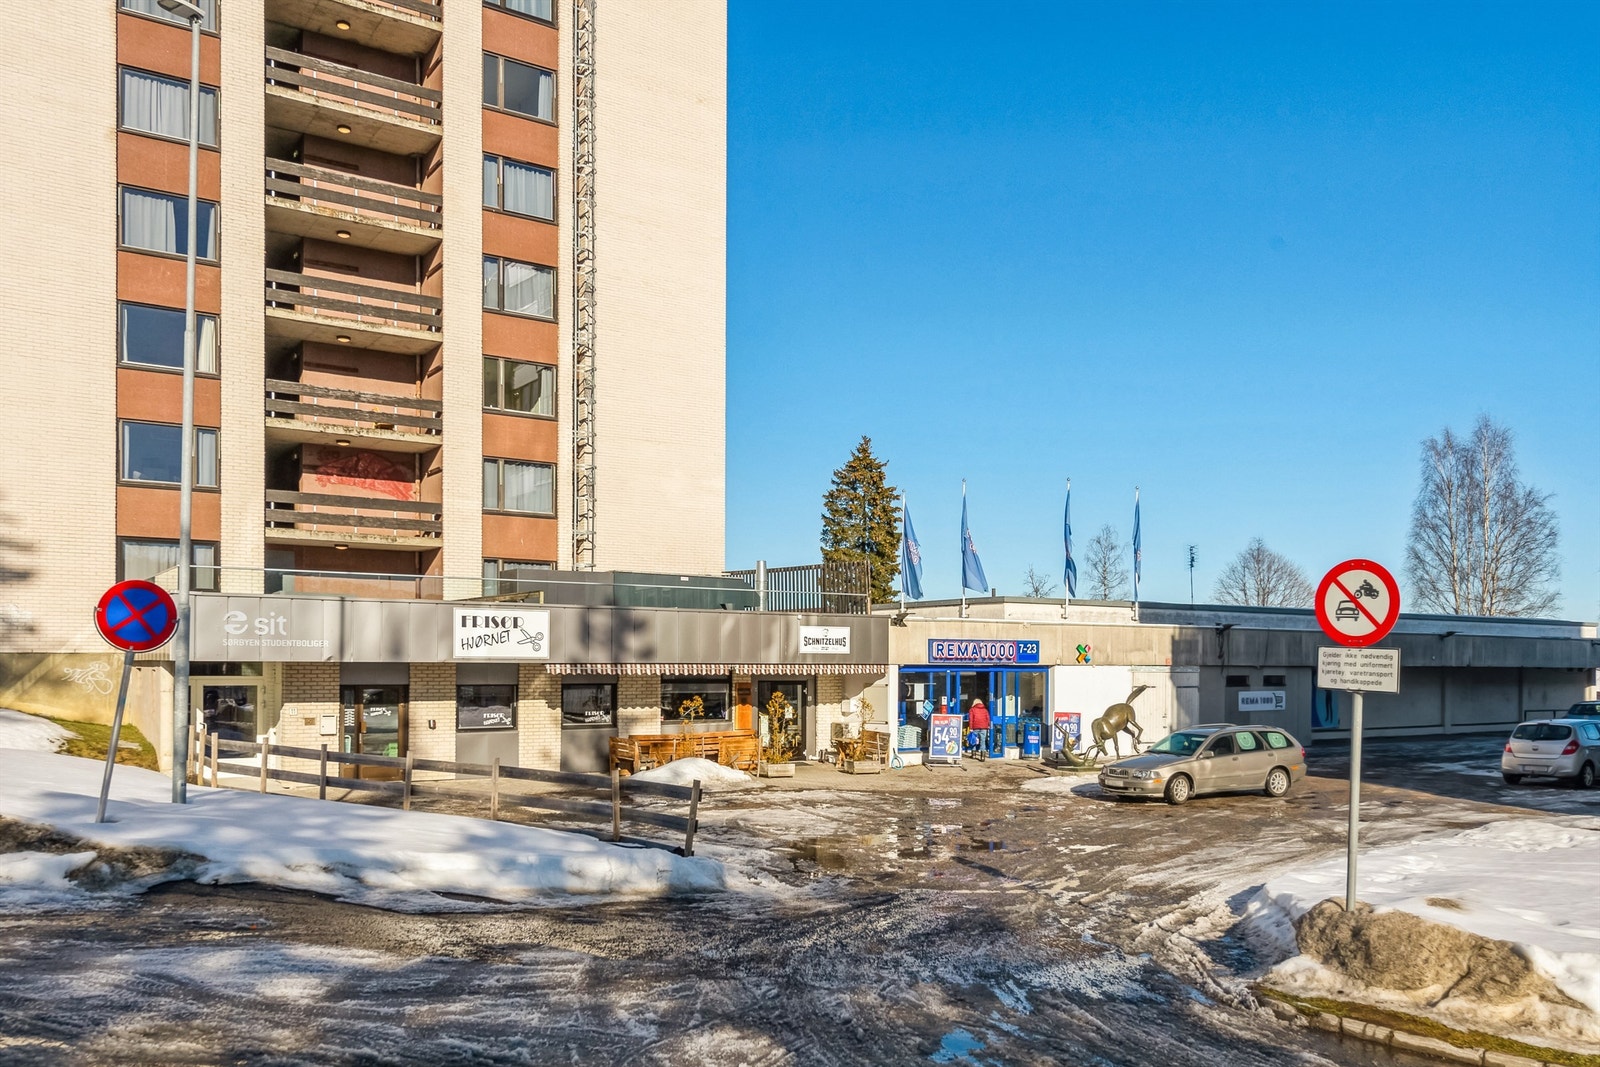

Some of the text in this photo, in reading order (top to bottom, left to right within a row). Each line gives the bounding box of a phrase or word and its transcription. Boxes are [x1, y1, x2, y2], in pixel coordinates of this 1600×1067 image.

[254, 611, 287, 636] sit
[461, 615, 525, 629] FRISØR
[222, 638, 329, 648] SØRBYEN STUDENTBOLIGER
[461, 629, 511, 651] HJØRNET
[803, 635, 847, 647] SCHNITZELHUS
[934, 642, 1015, 659] REMA 1000
[1018, 643, 1037, 654] 7-23
[1322, 651, 1342, 659] Gjelder
[1360, 653, 1394, 661] nødvendig
[1360, 661, 1393, 669] uniformert
[1349, 670, 1393, 678] varetransport
[1340, 678, 1383, 686] handikappede
[1241, 697, 1274, 705] REMA 1000
[933, 726, 950, 745] 54
